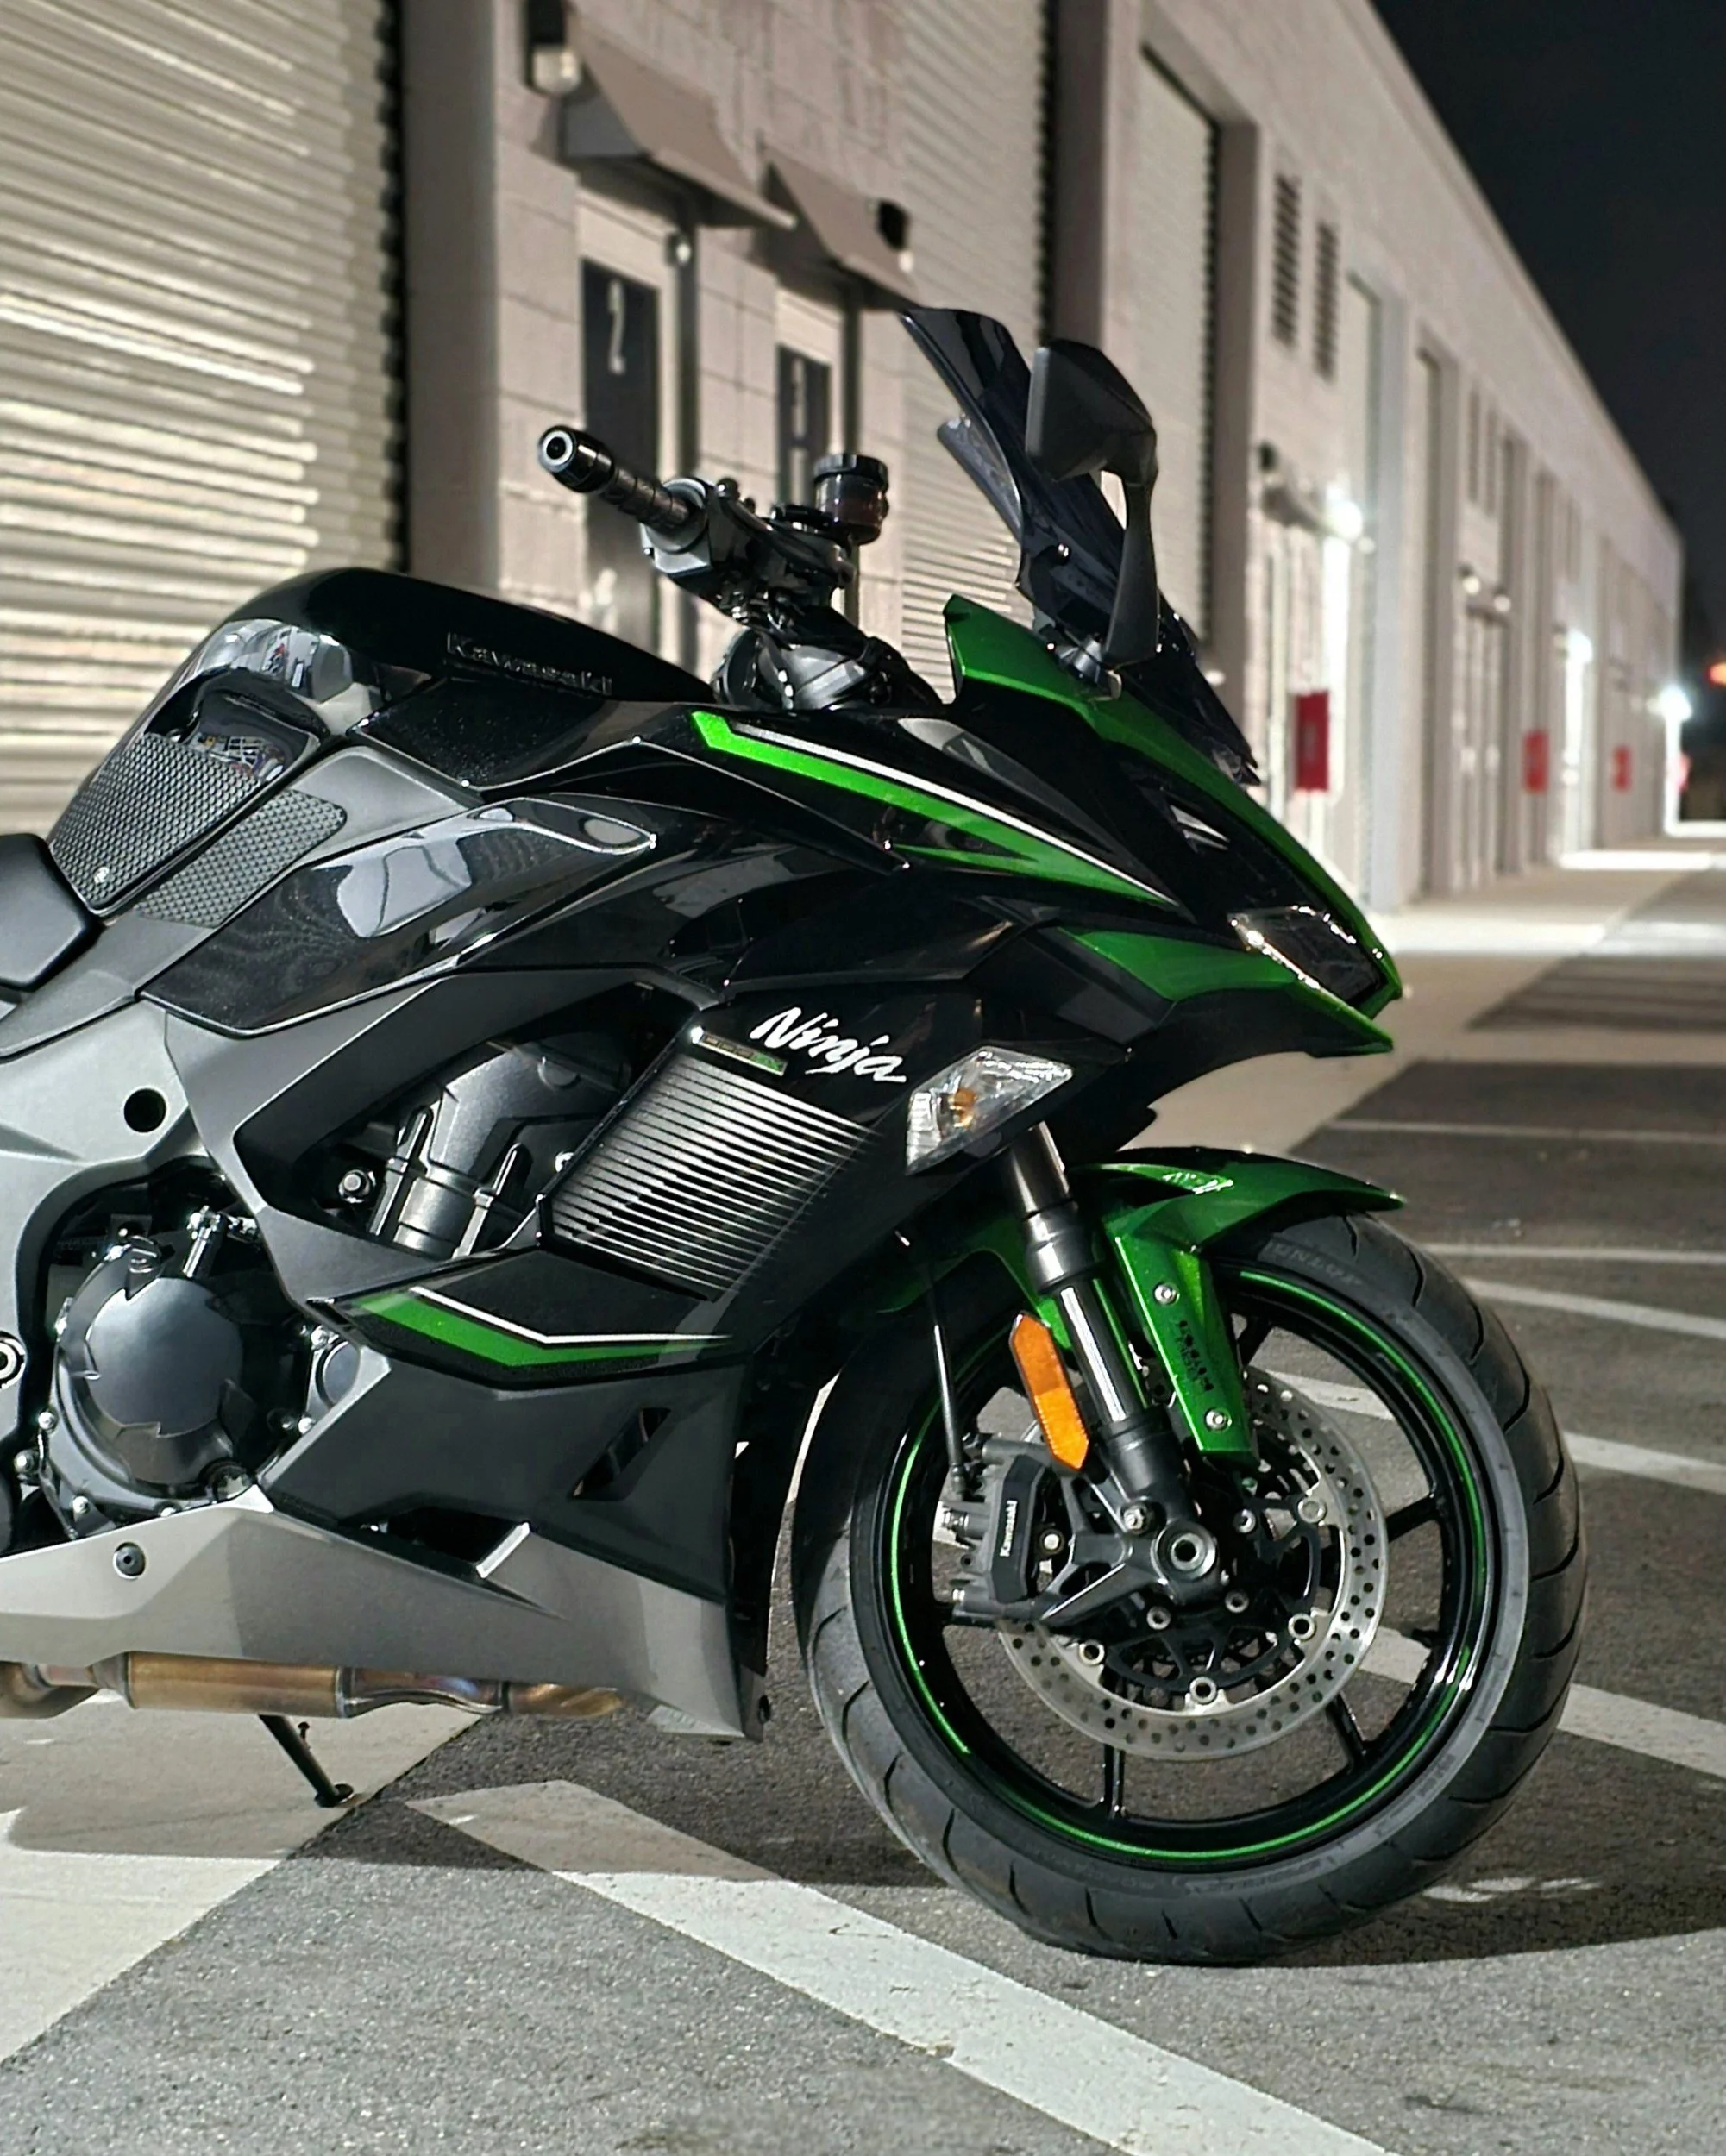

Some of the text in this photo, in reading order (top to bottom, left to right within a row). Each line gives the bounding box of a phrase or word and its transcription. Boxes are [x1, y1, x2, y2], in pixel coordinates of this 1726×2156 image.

[446, 631, 613, 697] Kawasaki
[750, 1007, 907, 1083] Ninja
[999, 1500, 1019, 1557] Kawasaki
